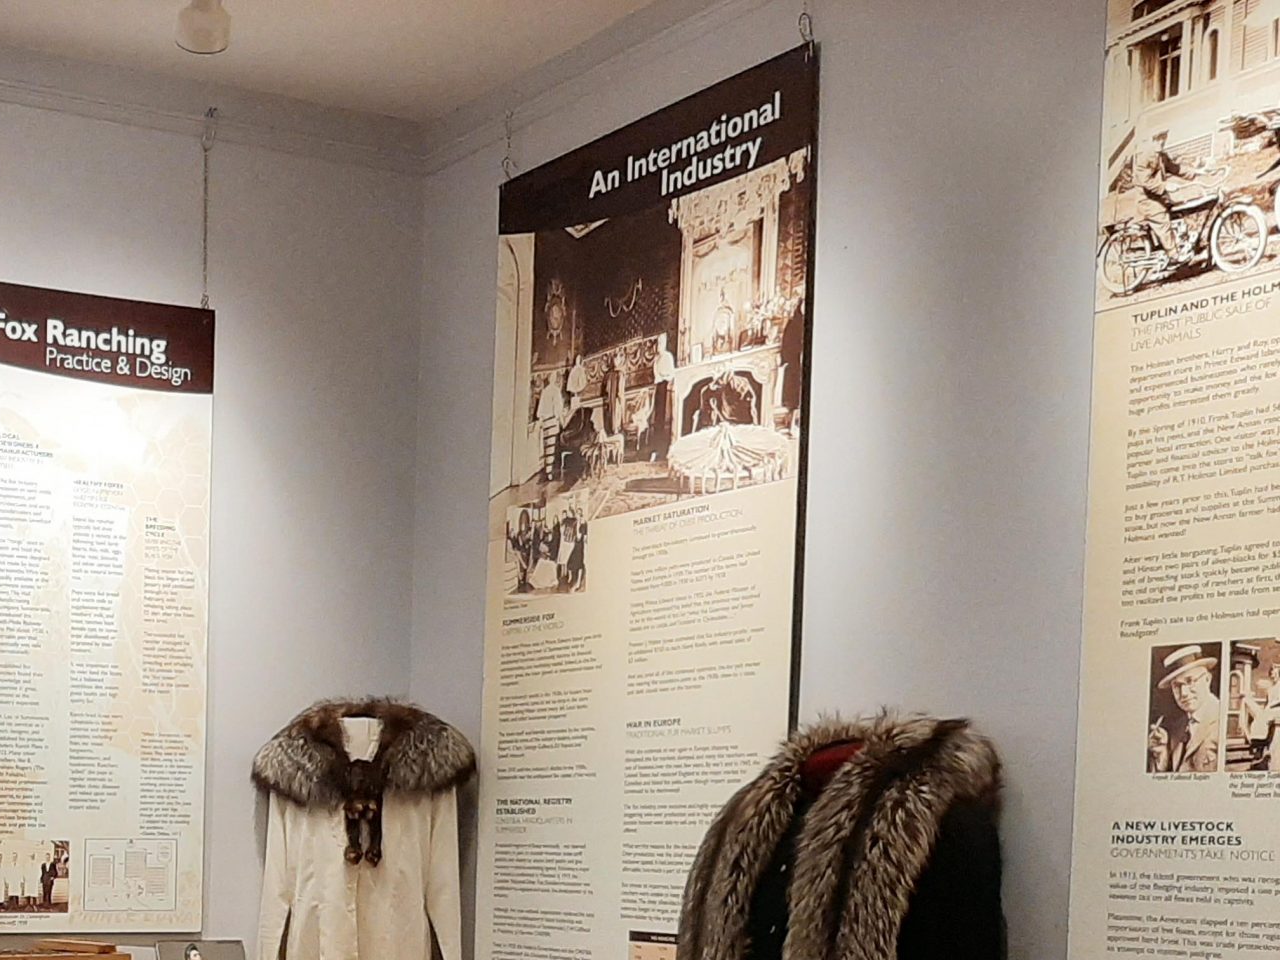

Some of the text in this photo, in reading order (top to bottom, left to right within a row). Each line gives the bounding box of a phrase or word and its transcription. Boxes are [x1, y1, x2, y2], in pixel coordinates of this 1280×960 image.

[588, 90, 781, 199] An International
[660, 137, 763, 196] Industry
[1131, 305, 1178, 324] TUPLIN
[1180, 298, 1209, 313] AND
[1210, 292, 1238, 306] THE
[1132, 296, 1273, 338] THE FIRST PUBLIC SALE OF
[45, 317, 168, 366] Ranching
[1130, 327, 1202, 352] LIVE ANIMALS
[45, 346, 192, 387] Practice & Design
[632, 504, 710, 526] MARKET SATURATION
[626, 718, 681, 729] WAR IN EUROPE
[1111, 821, 1235, 832] A NEW LIVESTOCK
[1111, 834, 1242, 846] INDUSTRY EMERGES
[1110, 847, 1276, 862] GOVERNMENTS TAKE NOTICE
